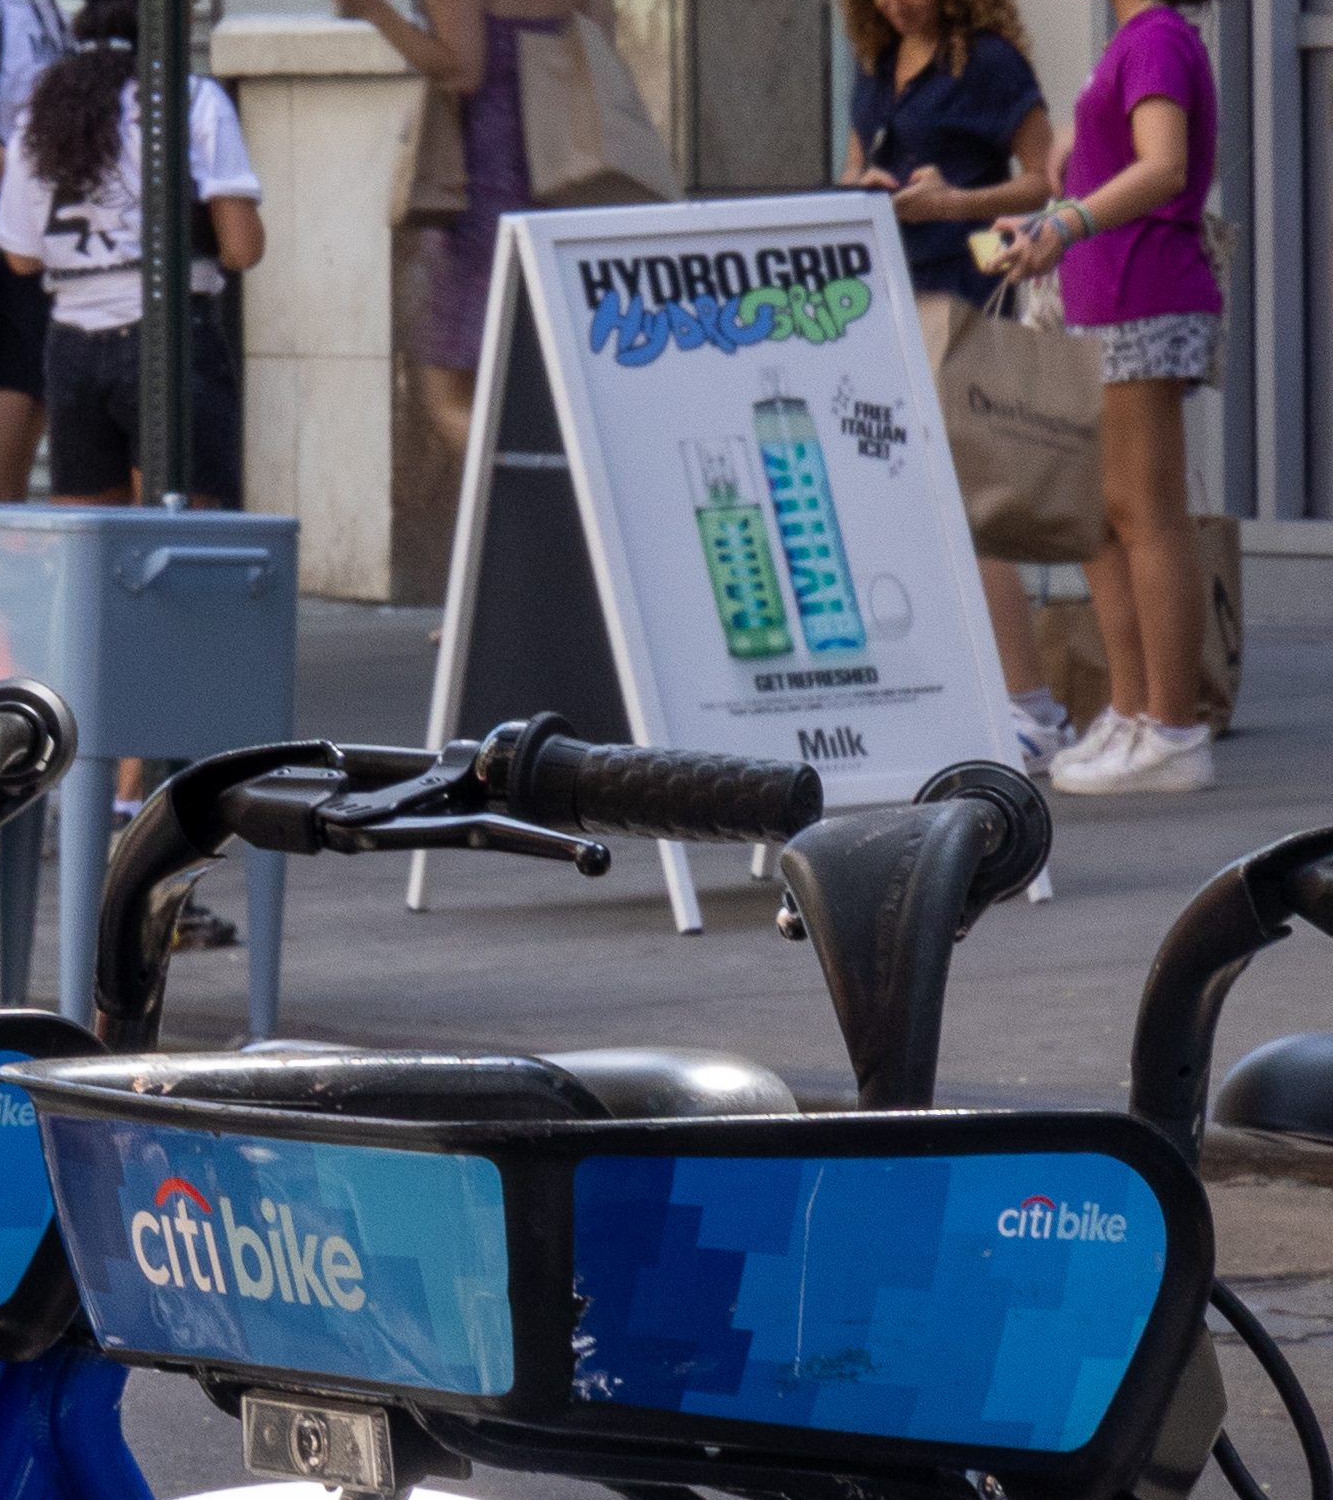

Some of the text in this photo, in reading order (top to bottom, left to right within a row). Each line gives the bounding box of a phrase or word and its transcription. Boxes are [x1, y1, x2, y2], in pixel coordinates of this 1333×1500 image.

[579, 242, 872, 310] HYDRO GRIP
[854, 400, 891, 421] FREE
[840, 418, 907, 444] ITALIAN
[754, 665, 879, 692] GET REFRESHED
[797, 726, 870, 761] Milk
[997, 1194, 1128, 1242] citi bike
[132, 1177, 367, 1311] citi bike
